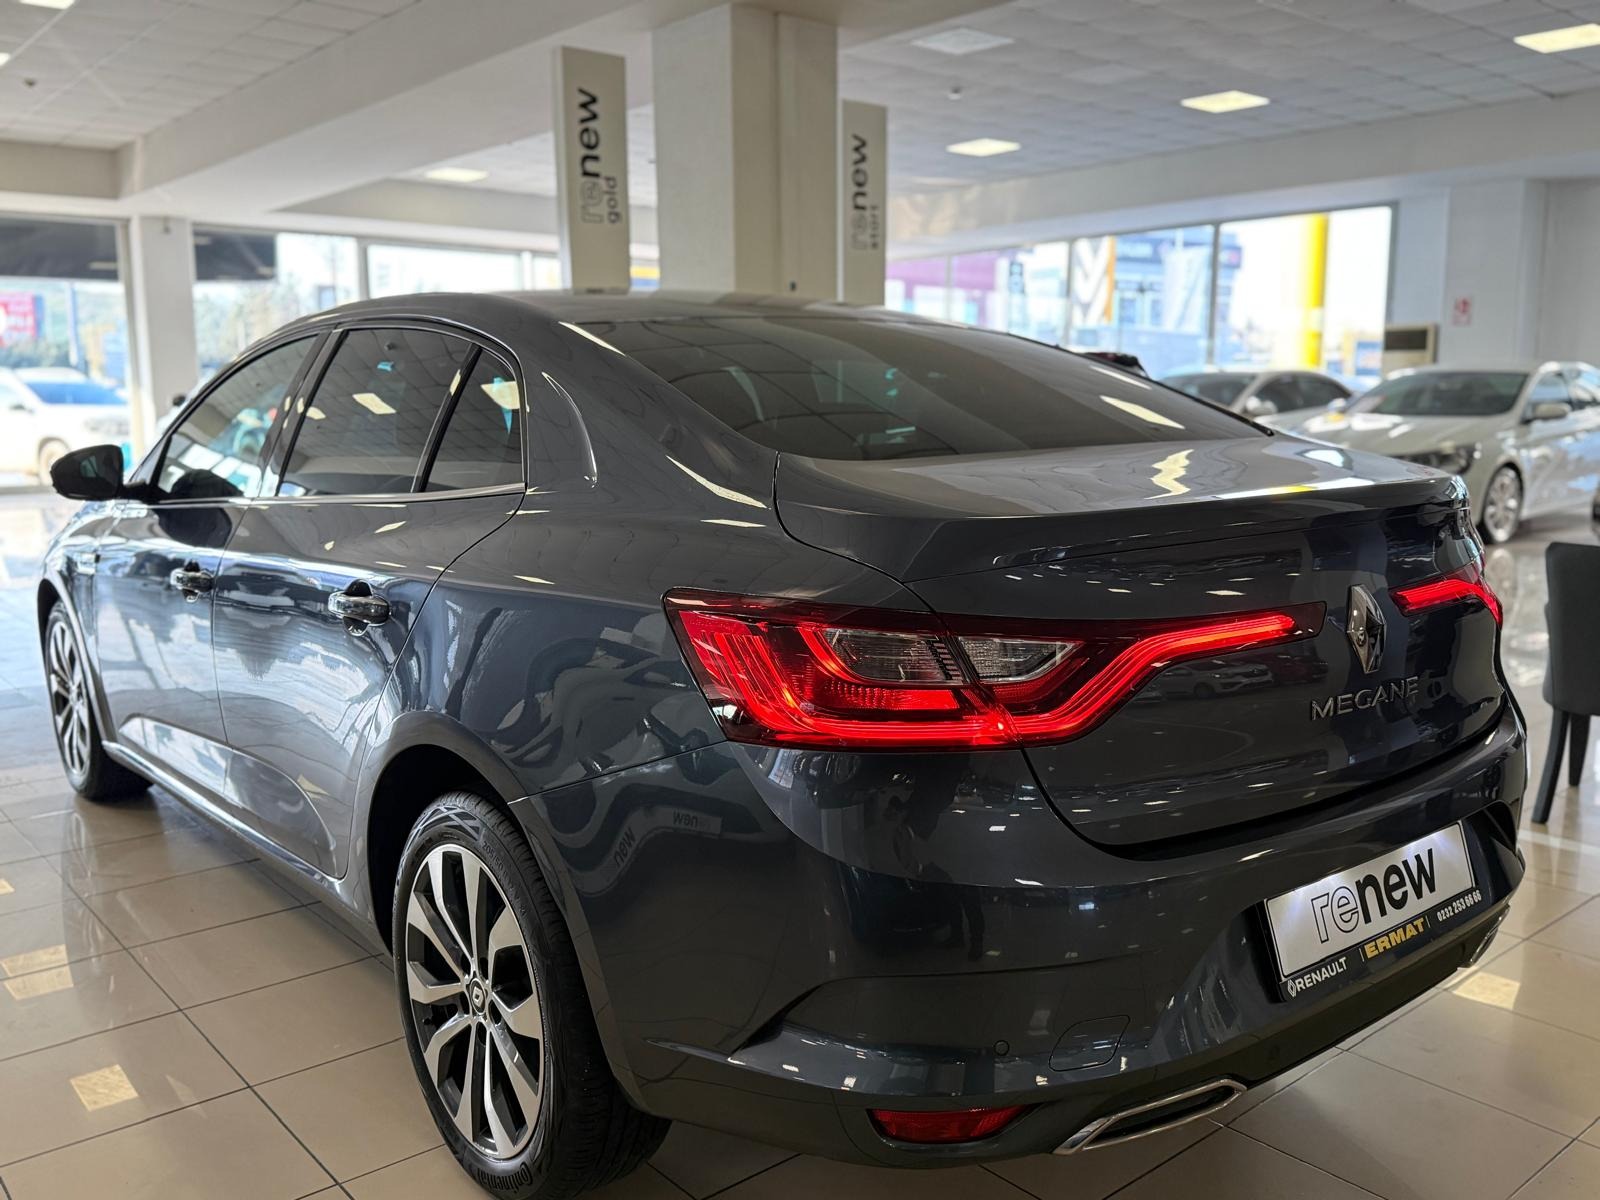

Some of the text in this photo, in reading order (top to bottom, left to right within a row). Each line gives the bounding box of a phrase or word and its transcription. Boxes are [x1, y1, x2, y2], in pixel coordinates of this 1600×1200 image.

[577, 87, 604, 225] renew
[602, 175, 622, 225] gold
[1310, 675, 1419, 721] MEGANE
[1295, 956, 1348, 993] RENAULT
[1363, 915, 1426, 960] ERMAT
[1436, 905, 1455, 922] 0232
[1452, 897, 1467, 914] 253
[1464, 893, 1475, 907] 66
[1310, 847, 1437, 945] renew
